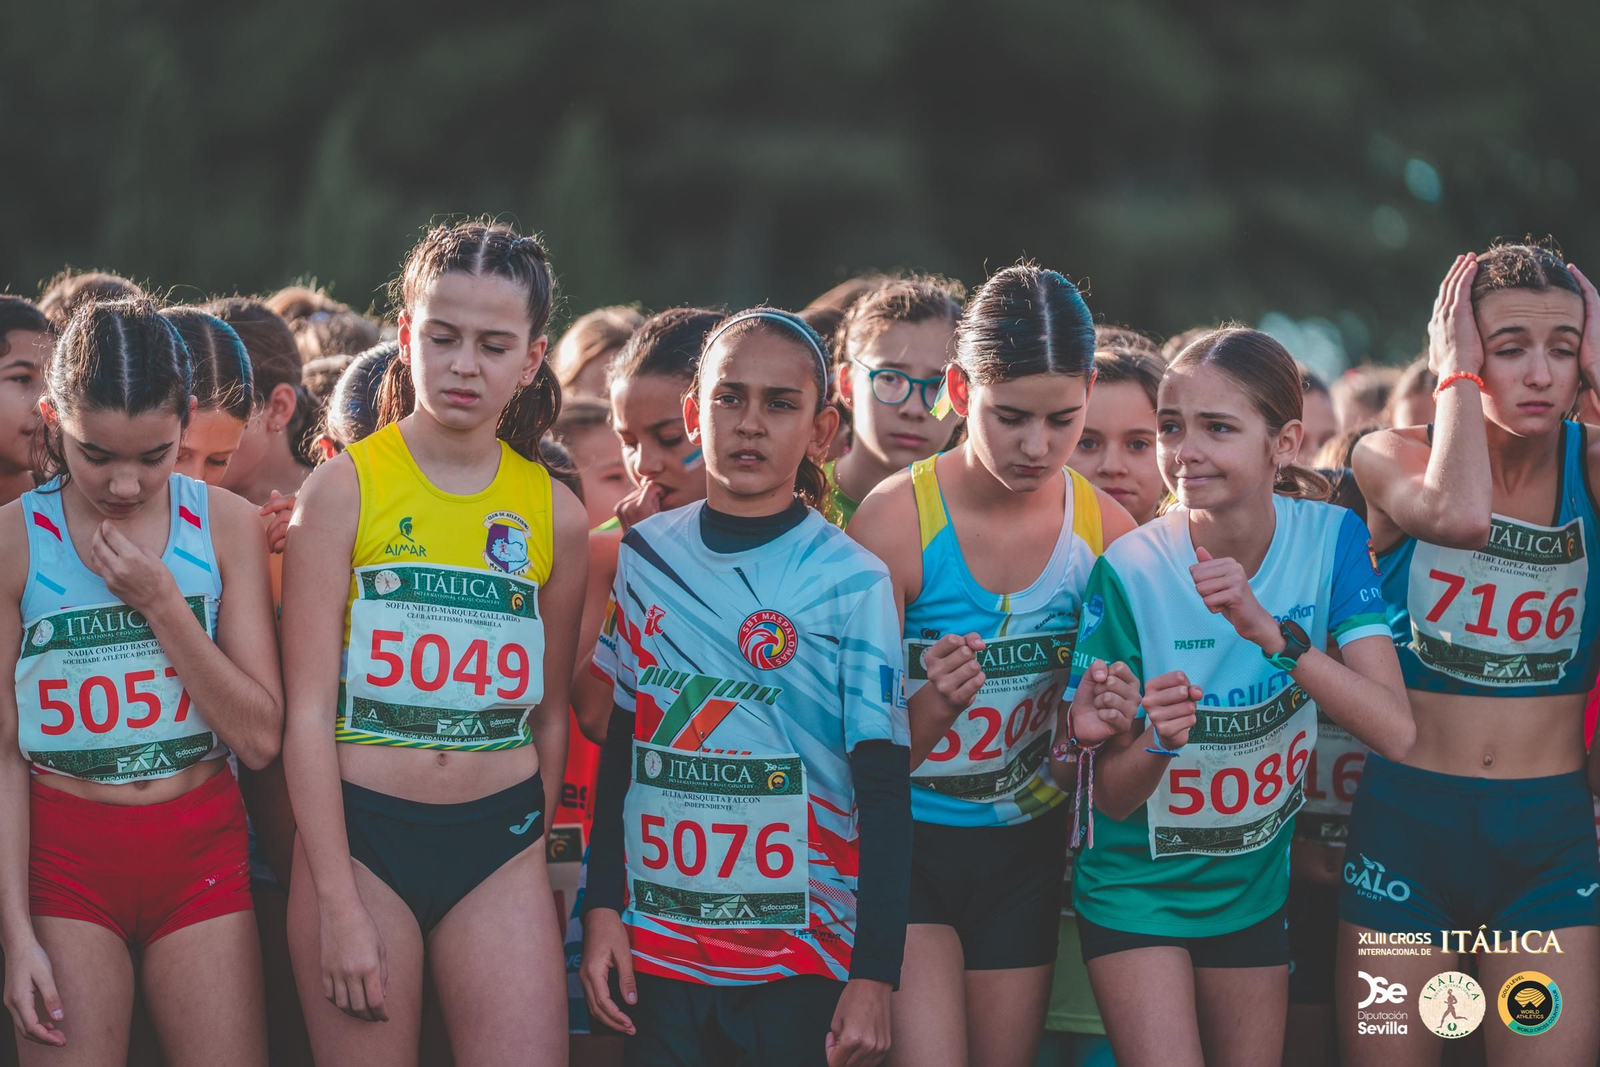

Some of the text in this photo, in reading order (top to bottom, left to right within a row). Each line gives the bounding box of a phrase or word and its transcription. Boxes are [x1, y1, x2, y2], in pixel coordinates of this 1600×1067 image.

[1489, 524, 1563, 554] TÁLICA
[385, 544, 427, 557] AIMAR
[1472, 552, 1497, 563] LEIRE
[1498, 559, 1524, 568] LOPEZ
[1500, 567, 1539, 579] GALOSPORT
[413, 570, 500, 600] ITÁLICA
[412, 604, 478, 618] NIETO-MARQUEZ
[479, 612, 521, 623] GALLARDO
[1425, 568, 1579, 641] 7166
[406, 612, 502, 628] CLUB ATLETISMO MEMBRILLA
[742, 612, 795, 666] SBT MASPALOMAS
[1174, 638, 1215, 650] FASTER
[62, 657, 101, 665] SOCIEDADE
[102, 652, 135, 661] ATLÉTICA
[96, 644, 129, 655] CONEJO
[975, 643, 1047, 668] TÁLICA
[366, 629, 530, 700] 5049
[1001, 676, 1029, 685] DURAN
[38, 667, 192, 735] 5057
[1205, 700, 1285, 733] ITÁLICA
[383, 729, 418, 741] FEDERACIÓN
[420, 735, 453, 743] ANDALUZA
[1228, 738, 1264, 751] FERRERA
[1264, 722, 1289, 741] CAMPOS
[1243, 745, 1266, 754] GILETE
[669, 757, 754, 784] ITÁLICA
[1168, 730, 1308, 815] 5086
[661, 790, 761, 804] JULIA ARISQUETA FALCON
[684, 802, 734, 811] INDEPENDIENTE
[641, 813, 794, 879] 5076
[1344, 861, 1411, 902] GALO
[1357, 889, 1383, 902] SPORT
